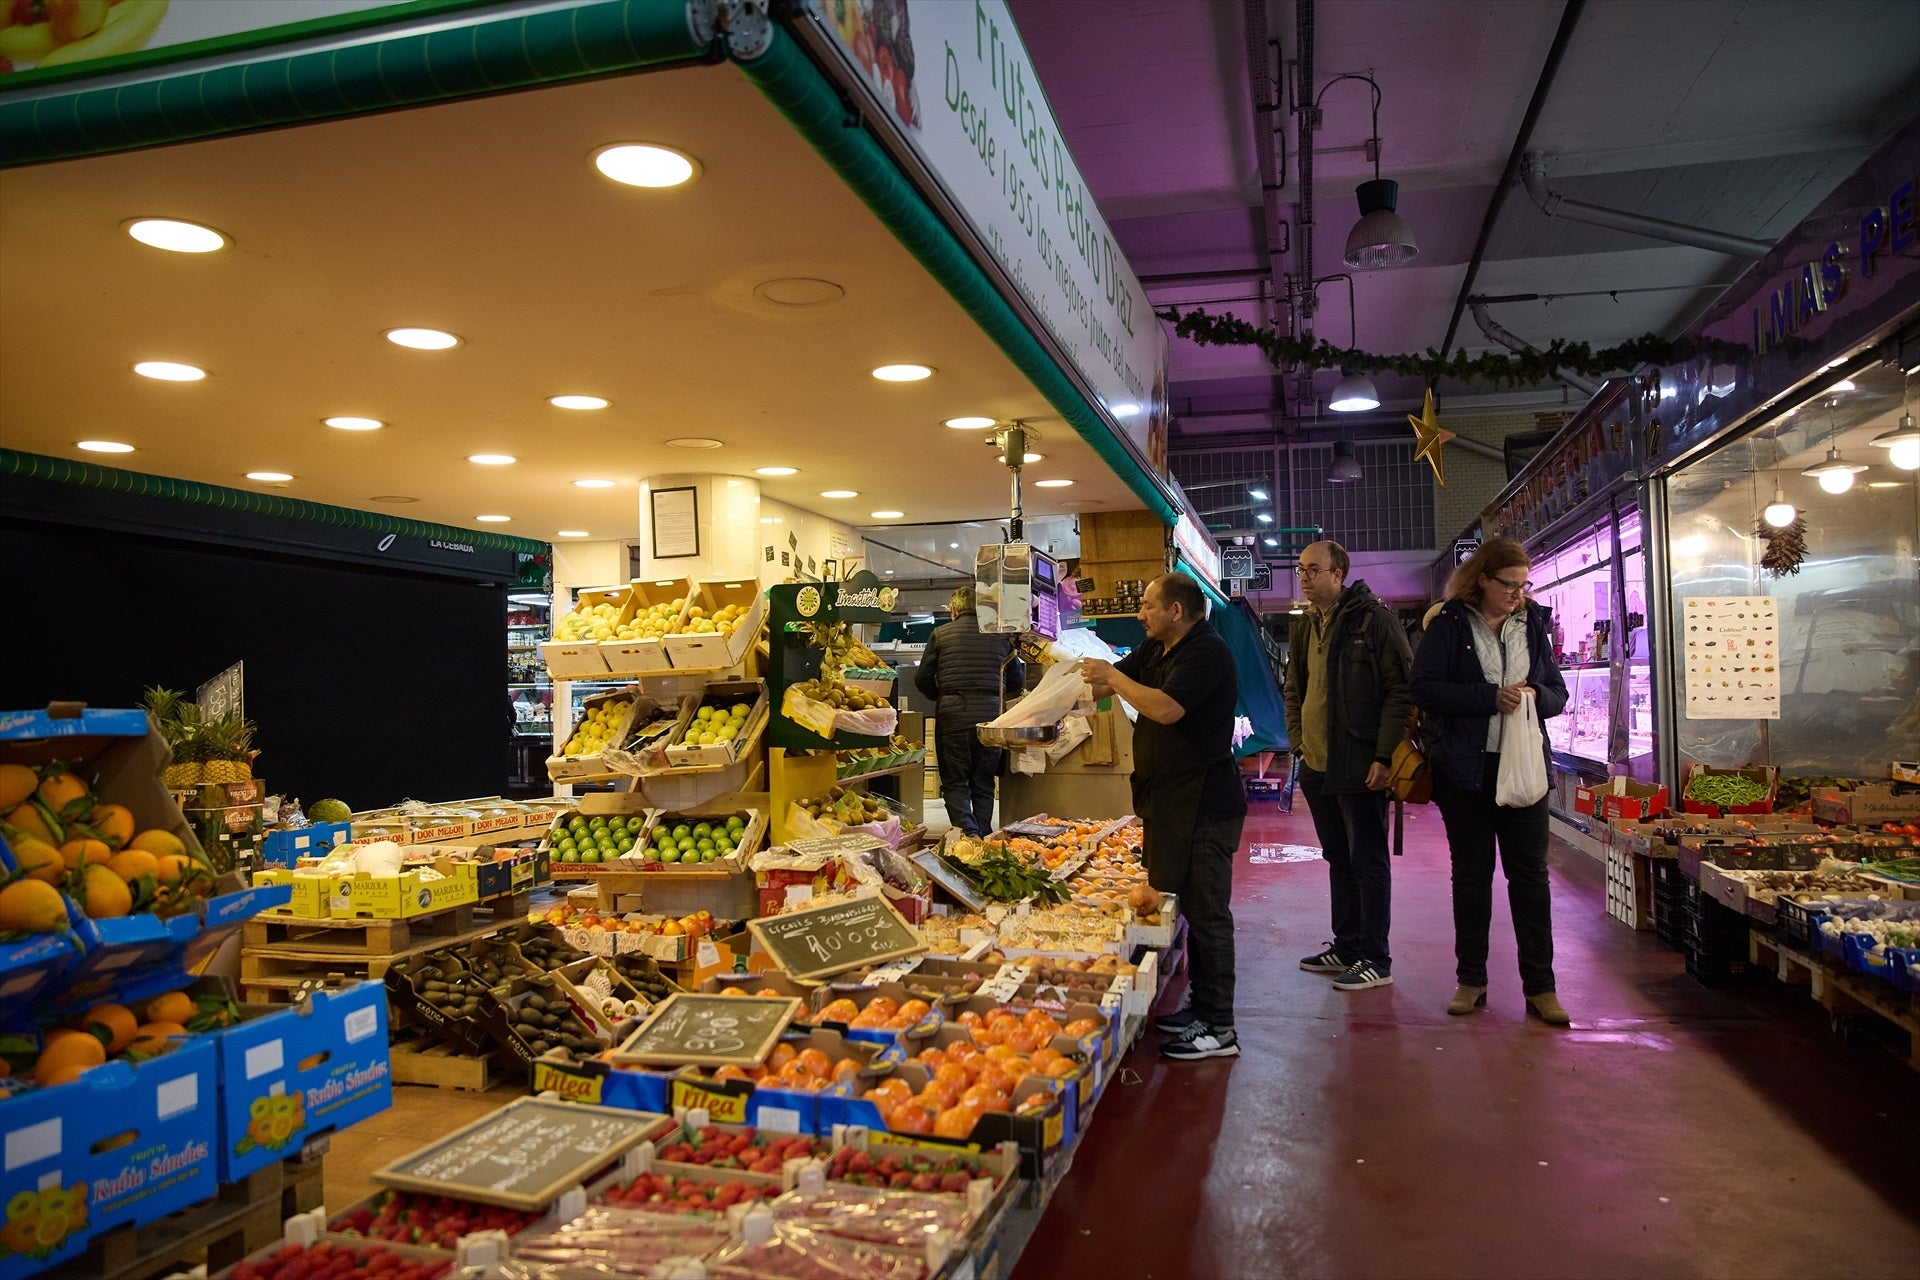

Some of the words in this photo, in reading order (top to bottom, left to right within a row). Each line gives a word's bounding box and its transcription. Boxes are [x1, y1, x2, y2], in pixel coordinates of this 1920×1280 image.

[944, 39, 995, 177] Desde
[1003, 149, 1033, 237] 1955
[1037, 203, 1052, 271] las
[1055, 250, 1088, 330] mejores
[1090, 298, 1111, 364] frutas
[1113, 336, 1124, 381] del
[1053, 133, 1100, 285] Pedro
[430, 539, 443, 549] LA
[443, 540, 475, 554] CEBADA
[477, 820, 493, 831] DON
[495, 815, 519, 828] MELON
[530, 813, 545, 823] DON
[417, 828, 435, 841] DON
[437, 824, 465, 837] MELON
[353, 881, 388, 891] MARZOLA
[433, 883, 465, 897] MARZOLA
[416, 1002, 445, 1024] EXÓTICA
[507, 1035, 532, 1062] EXÓTICA
[307, 1078, 344, 1109] Rubio
[345, 1059, 388, 1092] Sánchez
[92, 1166, 147, 1205] Rubio
[150, 1139, 208, 1181] Sánchez
